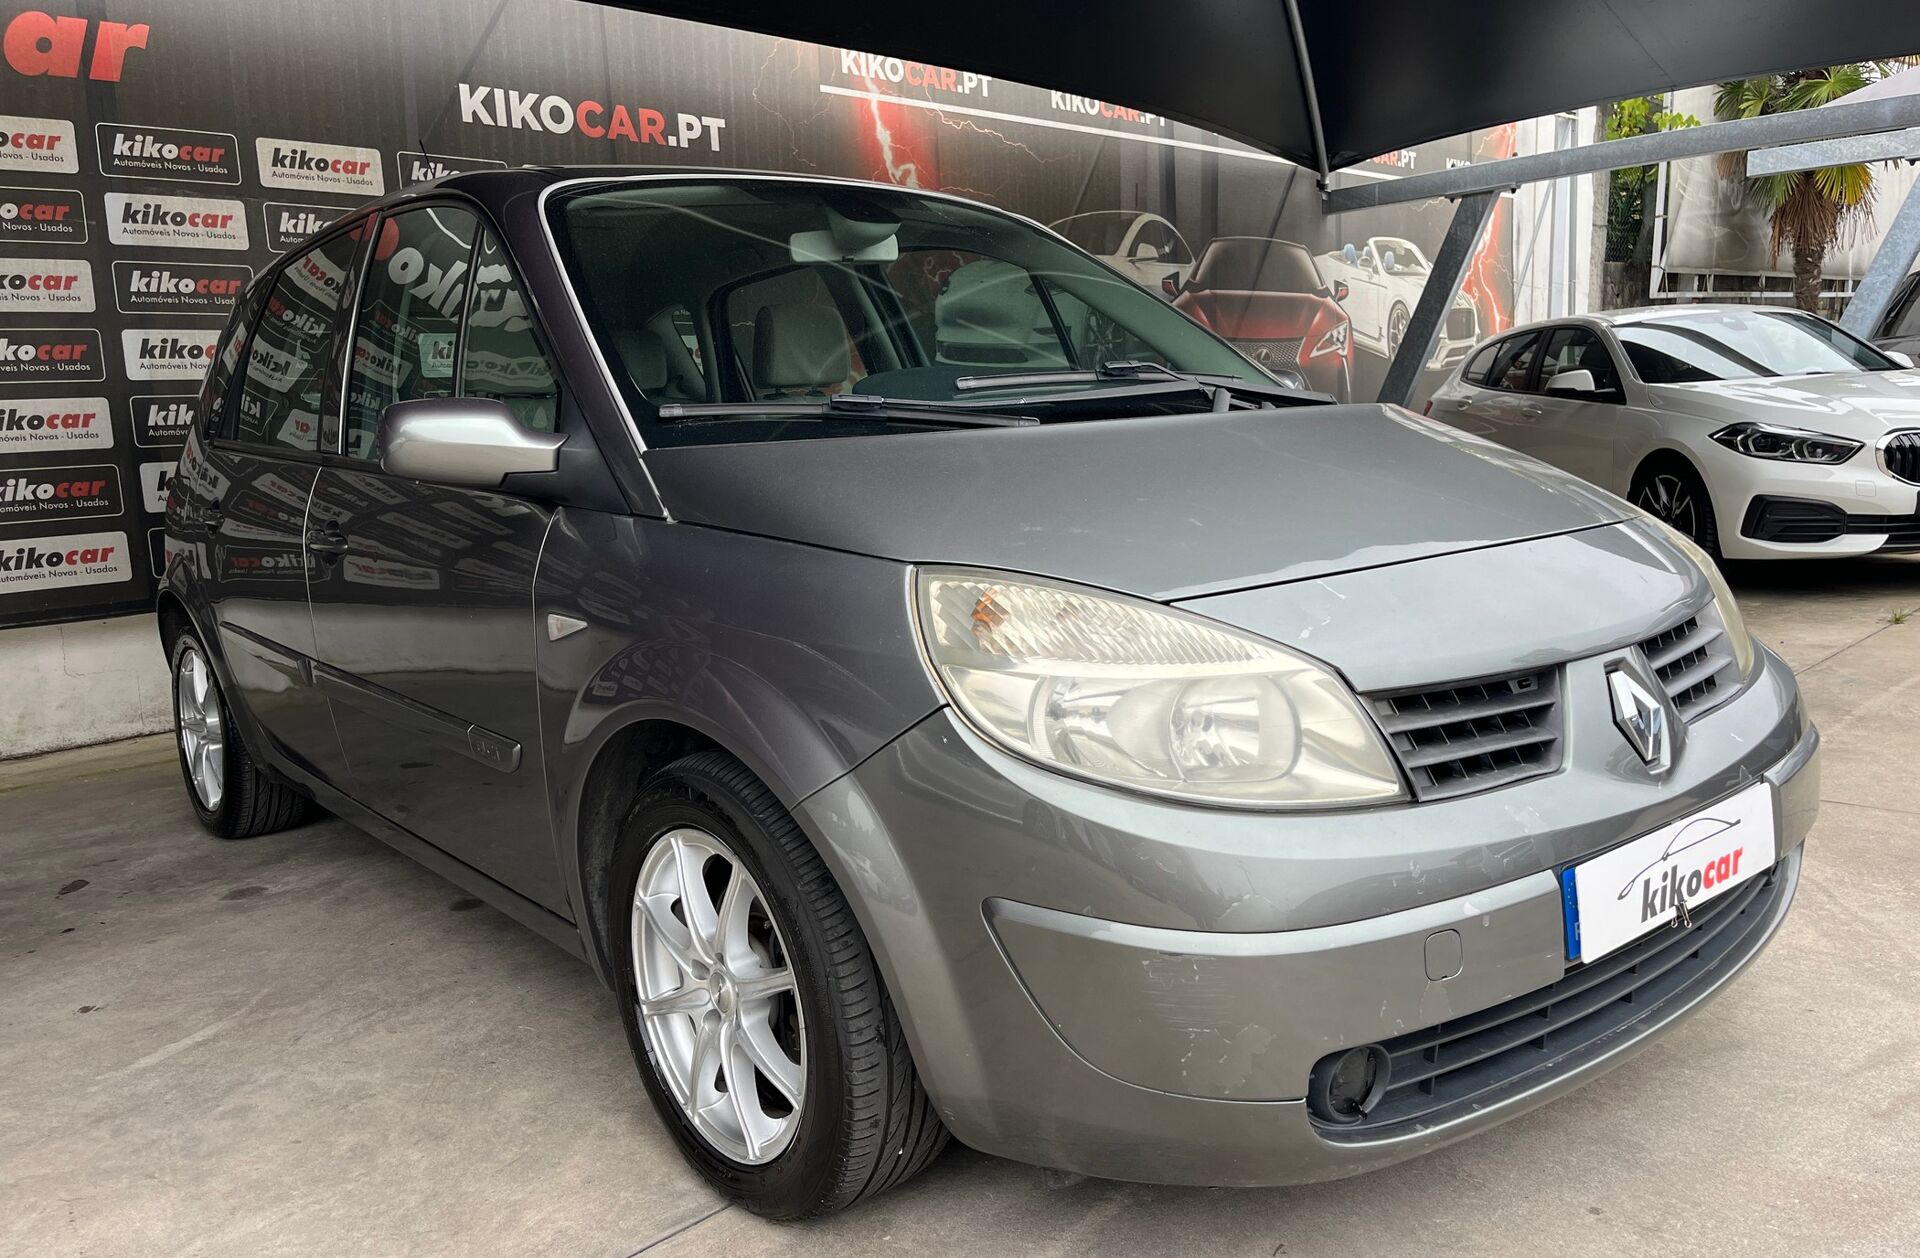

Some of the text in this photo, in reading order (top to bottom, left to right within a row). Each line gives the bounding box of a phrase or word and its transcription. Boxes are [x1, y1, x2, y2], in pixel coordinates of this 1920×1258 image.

[840, 48, 993, 97] KIKOCAR.PT
[458, 83, 726, 152] KIKOCAR.PT
[113, 133, 225, 163] kikocar
[31, 152, 65, 162] Usados
[271, 147, 371, 176] kikocar
[113, 158, 162, 169] Automóveis
[164, 161, 191, 171] Novos
[197, 164, 228, 174] Usados
[411, 161, 460, 181] kik
[271, 170, 315, 181] Automóveis
[317, 174, 341, 184] Novos
[346, 177, 373, 186] Usados
[122, 202, 234, 229] kikocar
[2, 222, 32, 231] Novos
[40, 223, 73, 232] Usados
[122, 227, 171, 237] Automóveis
[173, 230, 200, 238] Novos
[206, 231, 237, 240] Usados
[129, 270, 241, 295] kikocar
[11, 293, 40, 301] Novos
[48, 293, 81, 302] Usados
[130, 295, 179, 304] Automóveis
[181, 296, 208, 304] Novos
[20, 362, 50, 371] Novos
[57, 362, 91, 371] Usados
[140, 362, 188, 370] Automóveis
[29, 433, 59, 441] Novos
[66, 431, 99, 440] Usados
[39, 501, 69, 510] Novos
[76, 498, 109, 508] Usados
[48, 570, 78, 578] Novos
[85, 565, 118, 575] Usados
[1641, 847, 1744, 923] kikocar
